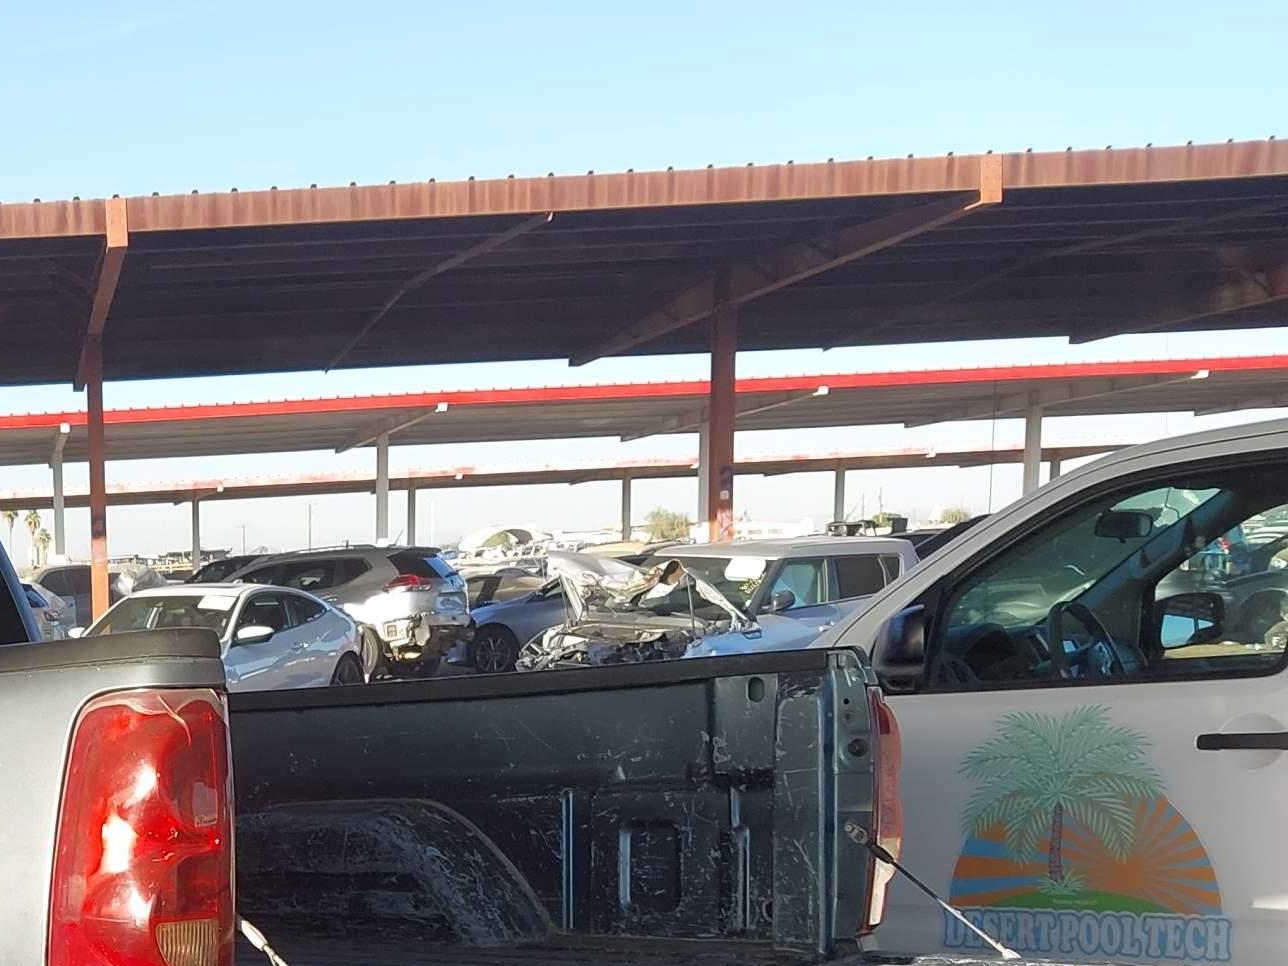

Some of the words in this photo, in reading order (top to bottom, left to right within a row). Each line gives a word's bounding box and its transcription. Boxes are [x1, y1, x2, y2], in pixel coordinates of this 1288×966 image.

[945, 908, 1055, 952] DESERT
[1059, 911, 1142, 957] POOL
[1142, 914, 1231, 961] TECH
